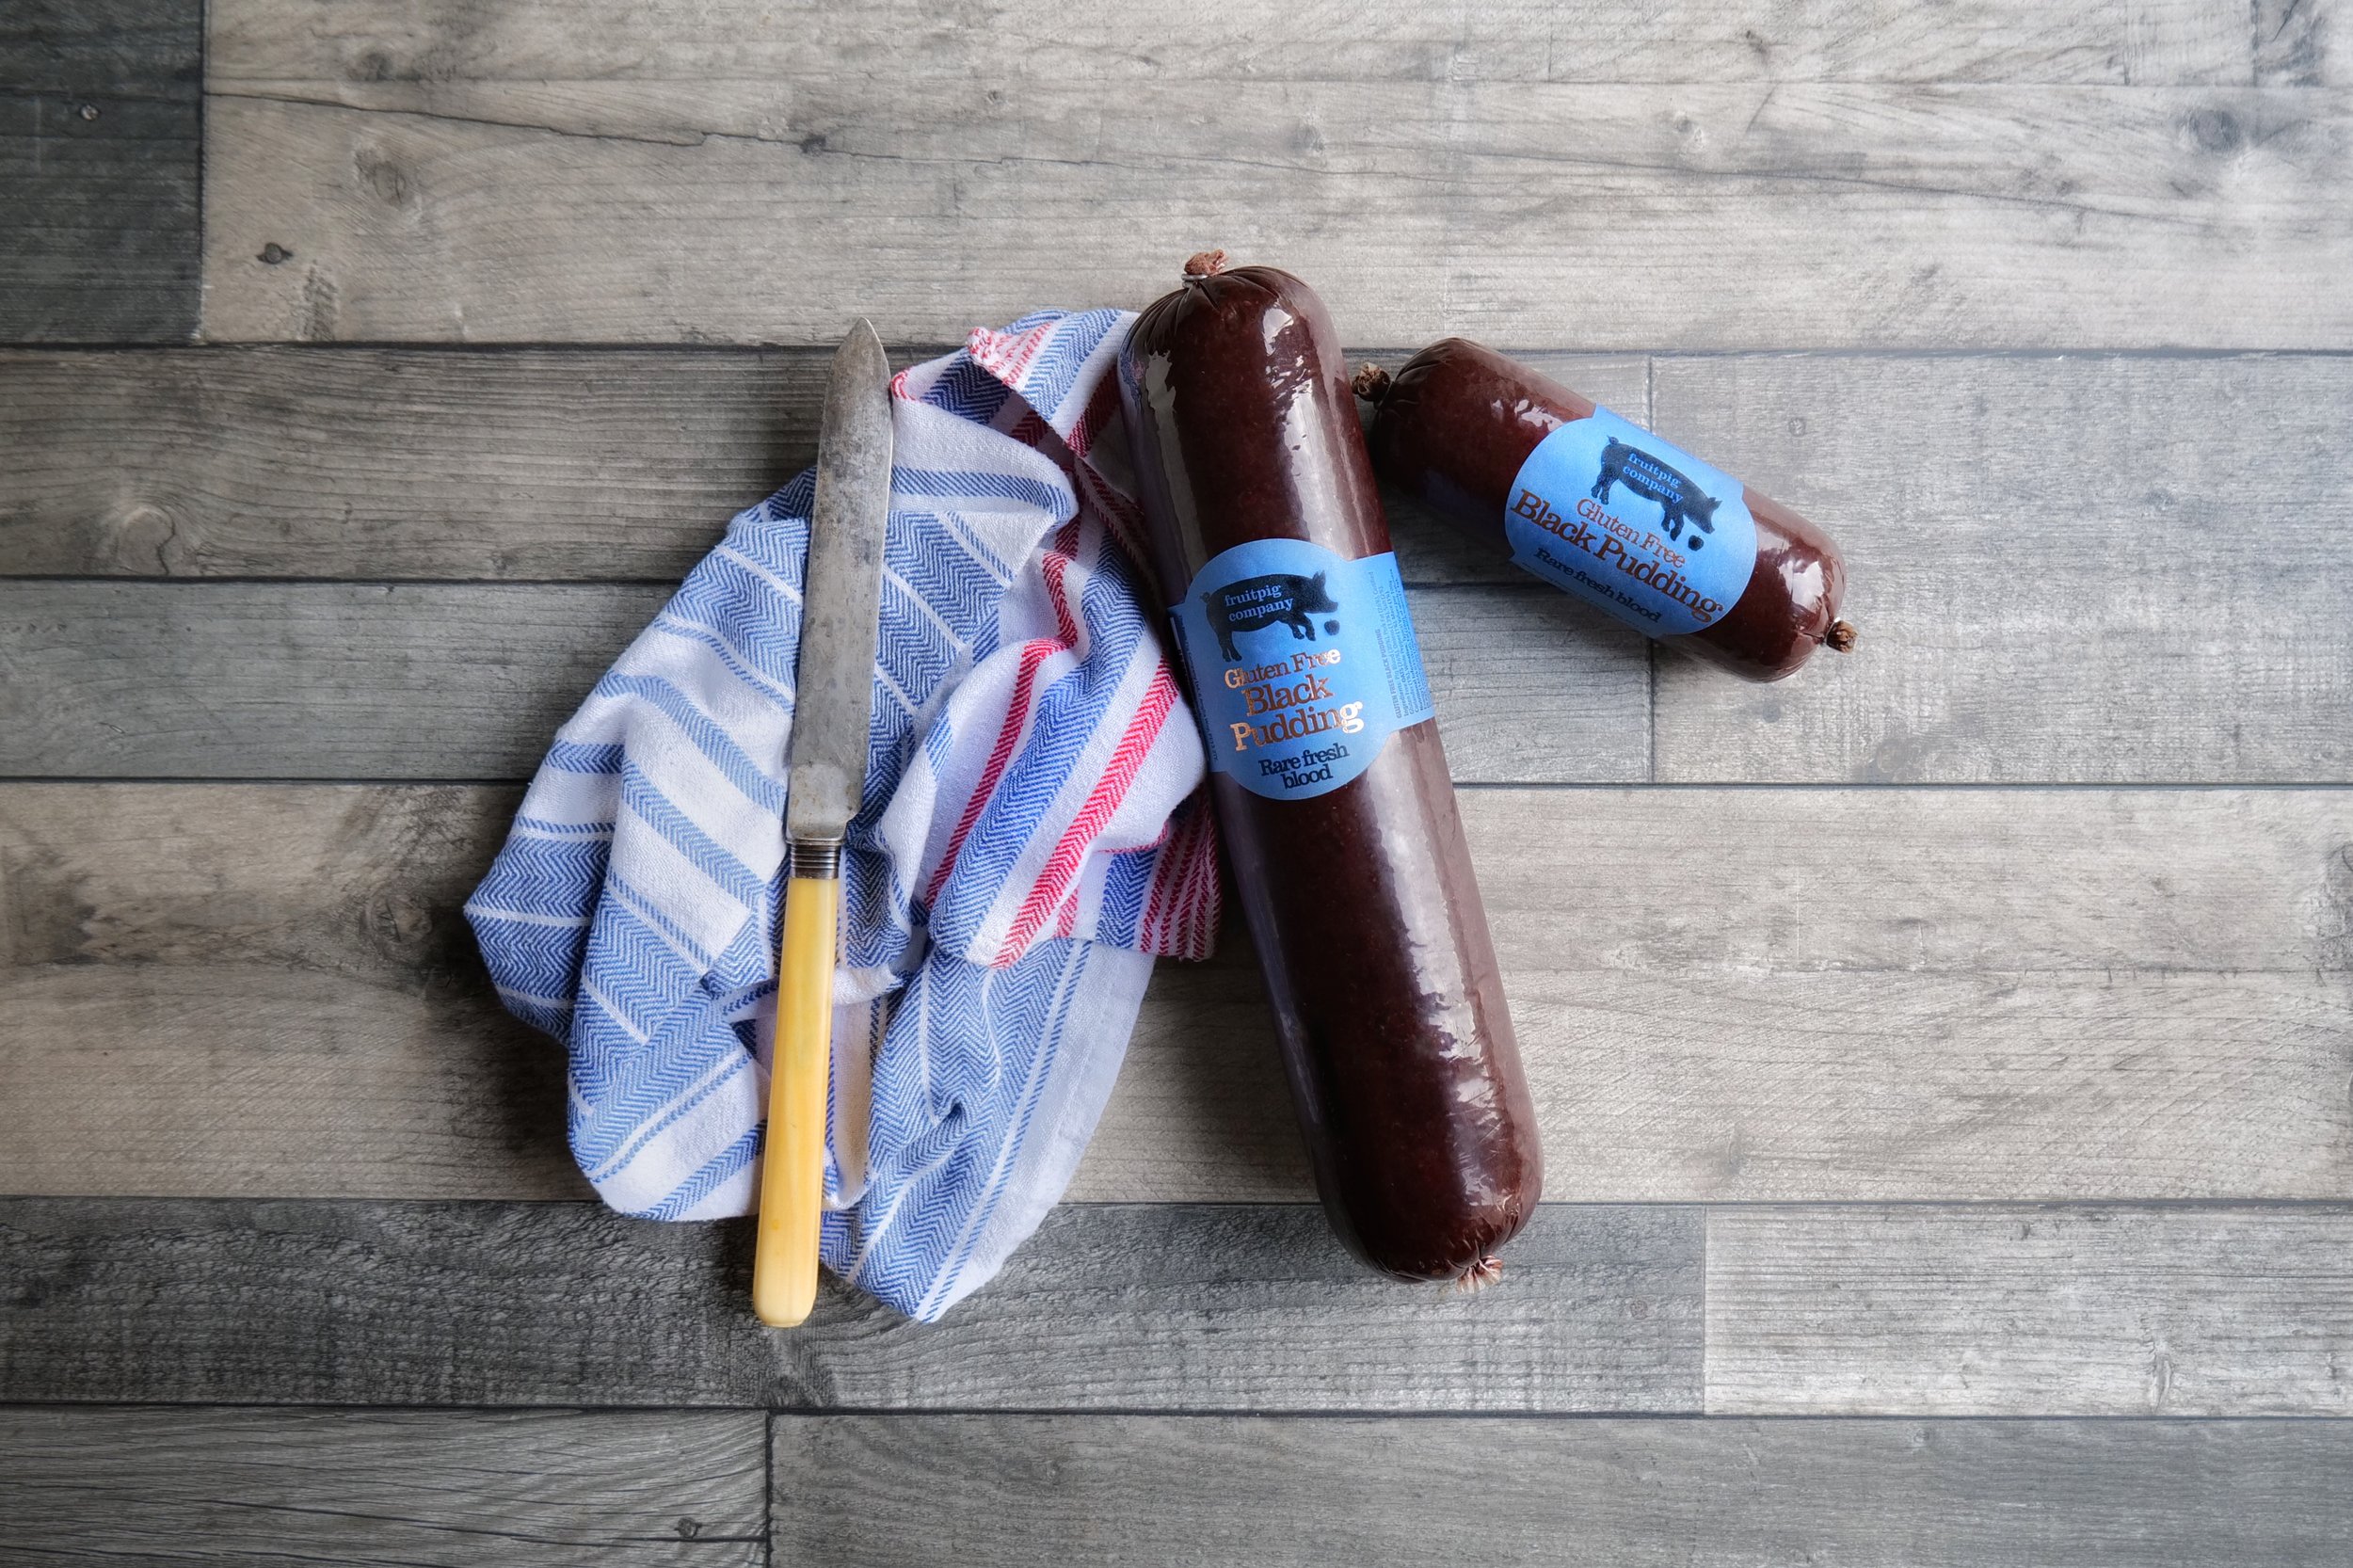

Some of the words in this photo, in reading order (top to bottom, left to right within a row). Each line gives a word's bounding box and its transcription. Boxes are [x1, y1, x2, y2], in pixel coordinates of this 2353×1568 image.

[1622, 465, 1684, 504] company
[1627, 453, 1682, 488] fruitpig
[1577, 498, 1641, 544] Gluten
[1639, 532, 1686, 568] Free
[1510, 488, 1597, 553] Black
[1593, 533, 1723, 623] Pudding
[1225, 584, 1282, 606] fruitpig
[1533, 548, 1575, 576] Rare
[1574, 570, 1615, 599] fresh
[1614, 591, 1663, 623] blood
[1228, 598, 1294, 622] company
[1374, 628, 1386, 657] PUDDING
[1224, 662, 1289, 690] Gluten
[1289, 648, 1341, 674] Free
[1382, 657, 1392, 679] BLACK
[1241, 673, 1335, 717] Black
[1387, 679, 1396, 695] FREE
[1391, 695, 1401, 718] GLUTEN
[1229, 700, 1365, 751] Pudding
[1258, 751, 1302, 776] Rare
[1303, 743, 1351, 770] fresh
[1280, 763, 1334, 790] blood
